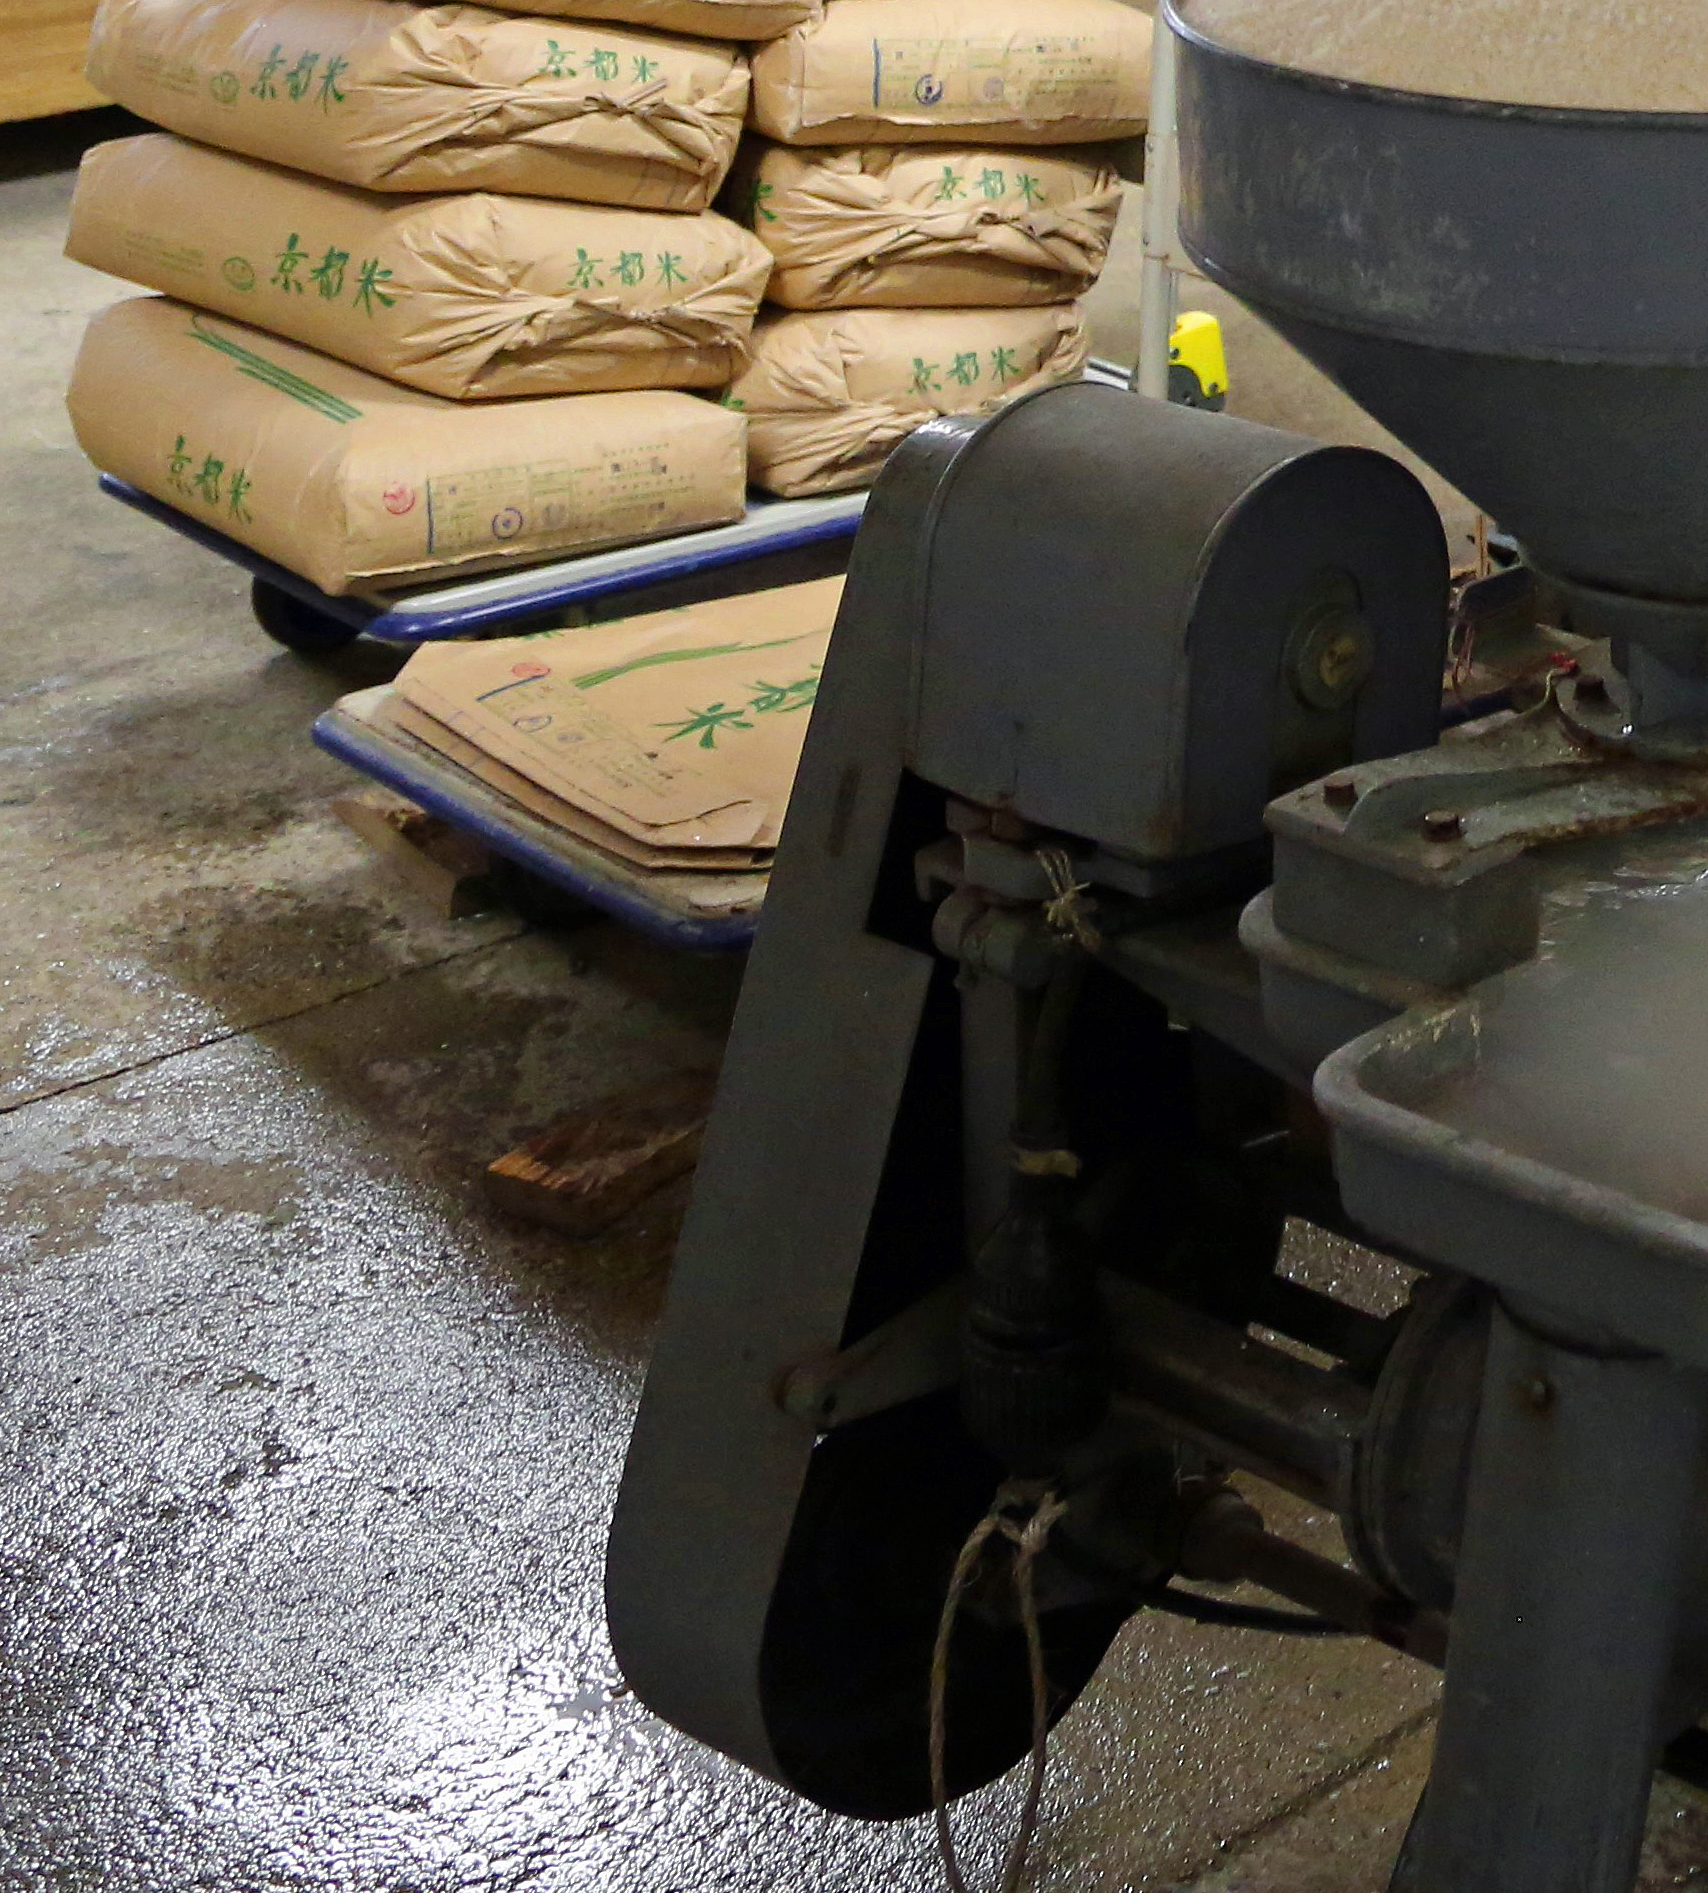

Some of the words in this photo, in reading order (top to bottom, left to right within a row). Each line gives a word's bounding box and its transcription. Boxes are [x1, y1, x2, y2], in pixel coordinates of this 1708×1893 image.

[250, 44, 349, 115] 京都米
[538, 39, 659, 84] 京都米
[935, 166, 1046, 206] 京都米
[271, 233, 396, 317] 京都米
[567, 245, 688, 292] 京都米
[907, 347, 1021, 393] 京都米
[166, 434, 252, 524] 京都米
